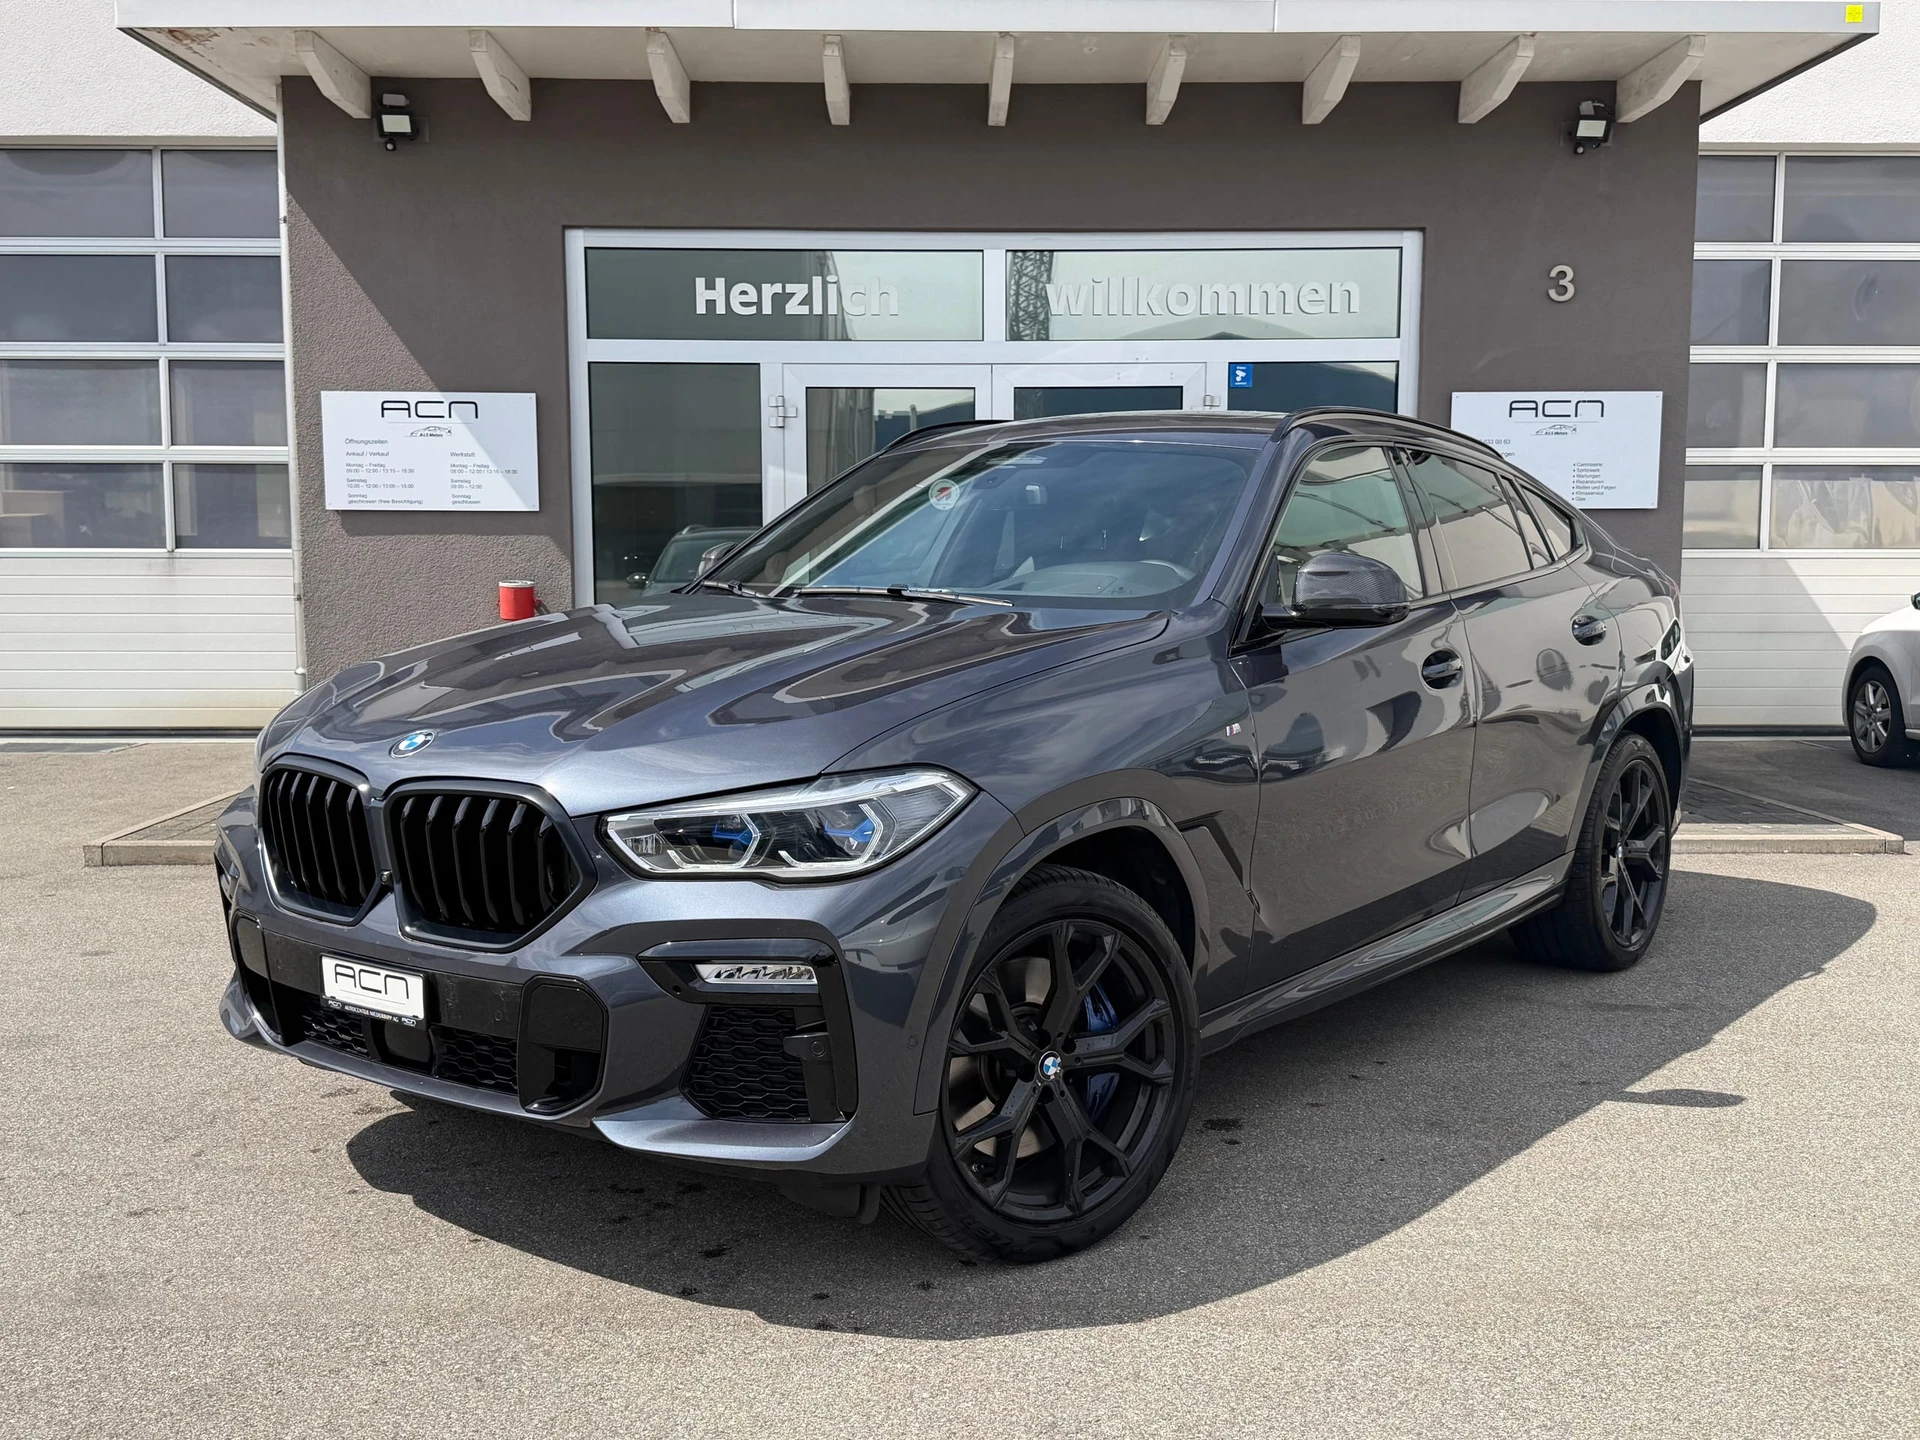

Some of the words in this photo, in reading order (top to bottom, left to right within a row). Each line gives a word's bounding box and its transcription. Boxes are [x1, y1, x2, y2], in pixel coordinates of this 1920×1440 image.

[695, 275, 899, 317] Herzlich
[1045, 276, 1360, 317] willkommen
[1548, 264, 1575, 302] 3
[381, 400, 479, 419] ACN
[1509, 400, 1604, 418] ACN
[334, 963, 409, 1000] ACN
